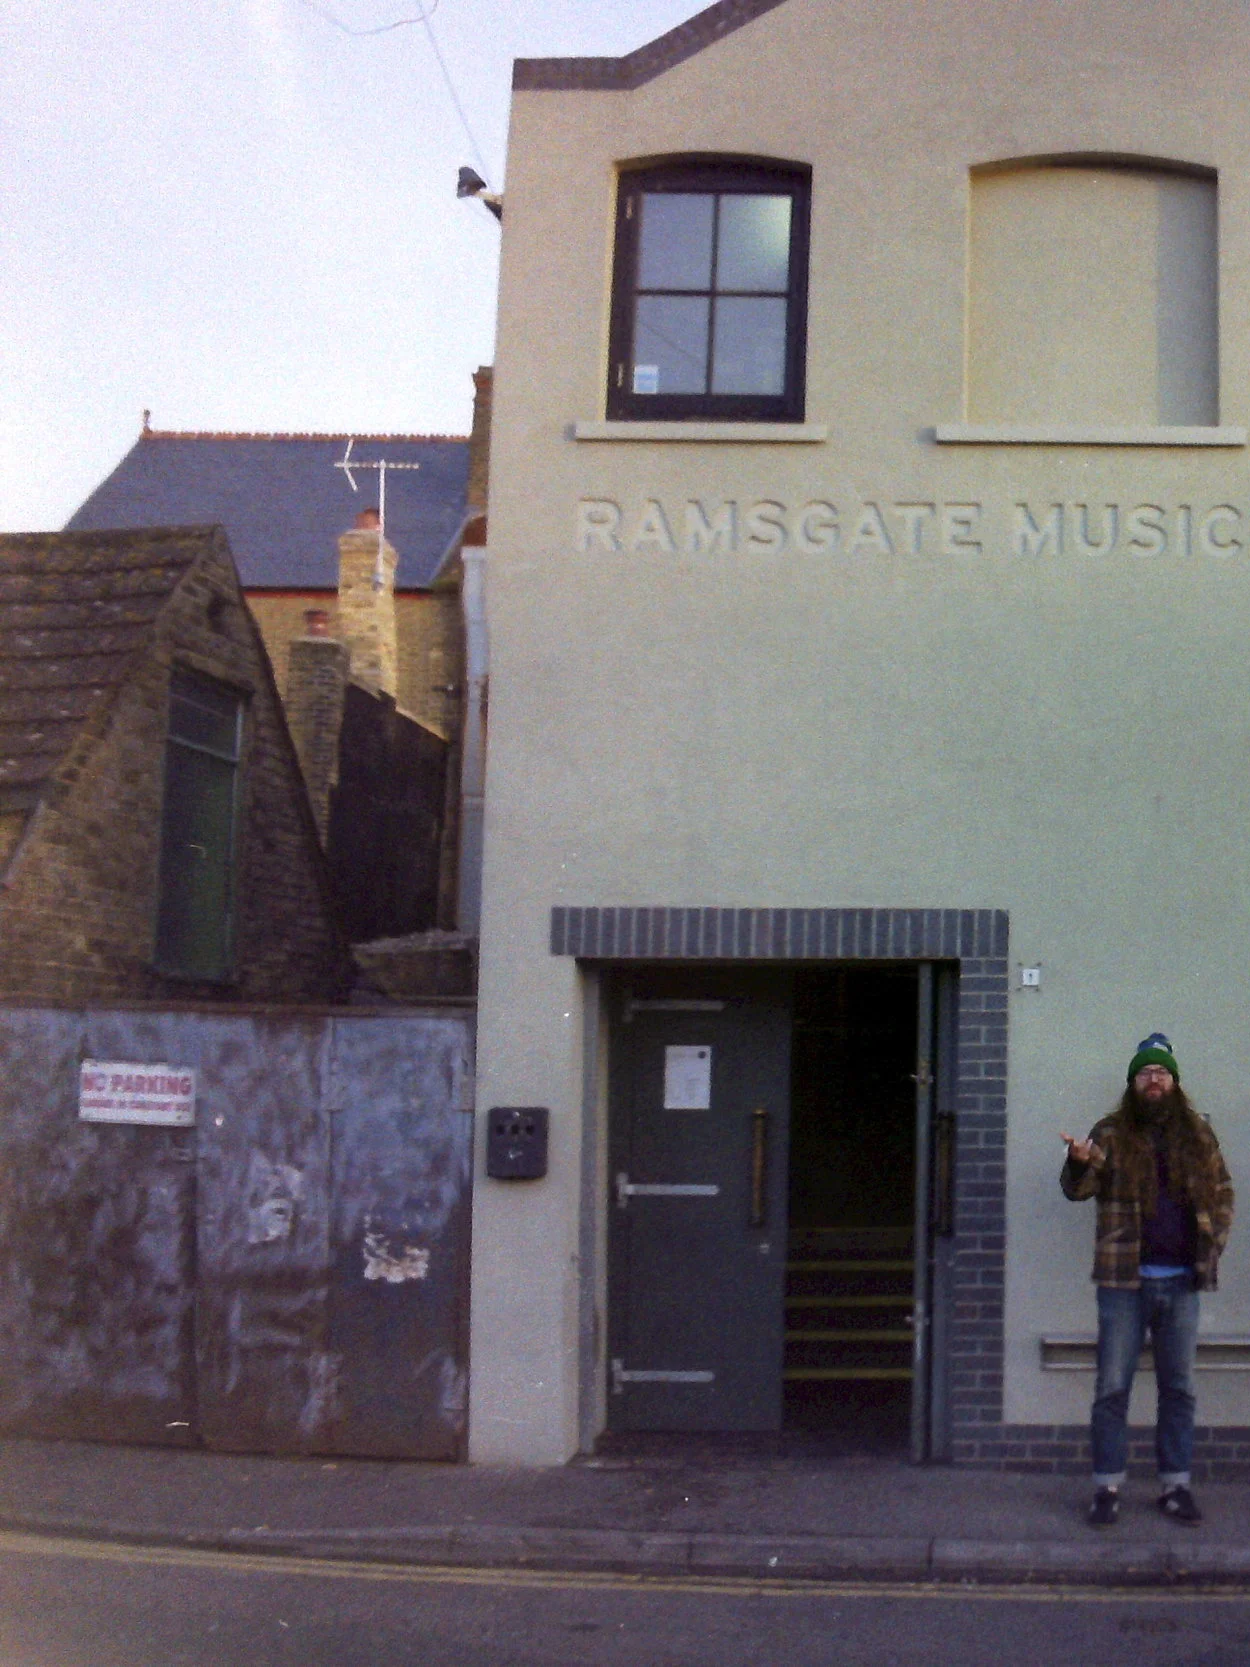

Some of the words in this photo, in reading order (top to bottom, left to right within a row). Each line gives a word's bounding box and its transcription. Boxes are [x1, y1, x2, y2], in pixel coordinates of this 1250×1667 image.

[576, 497, 984, 554] RAMSGATE
[1014, 502, 1243, 558] MUSIC
[110, 1073, 193, 1097] PARKING
